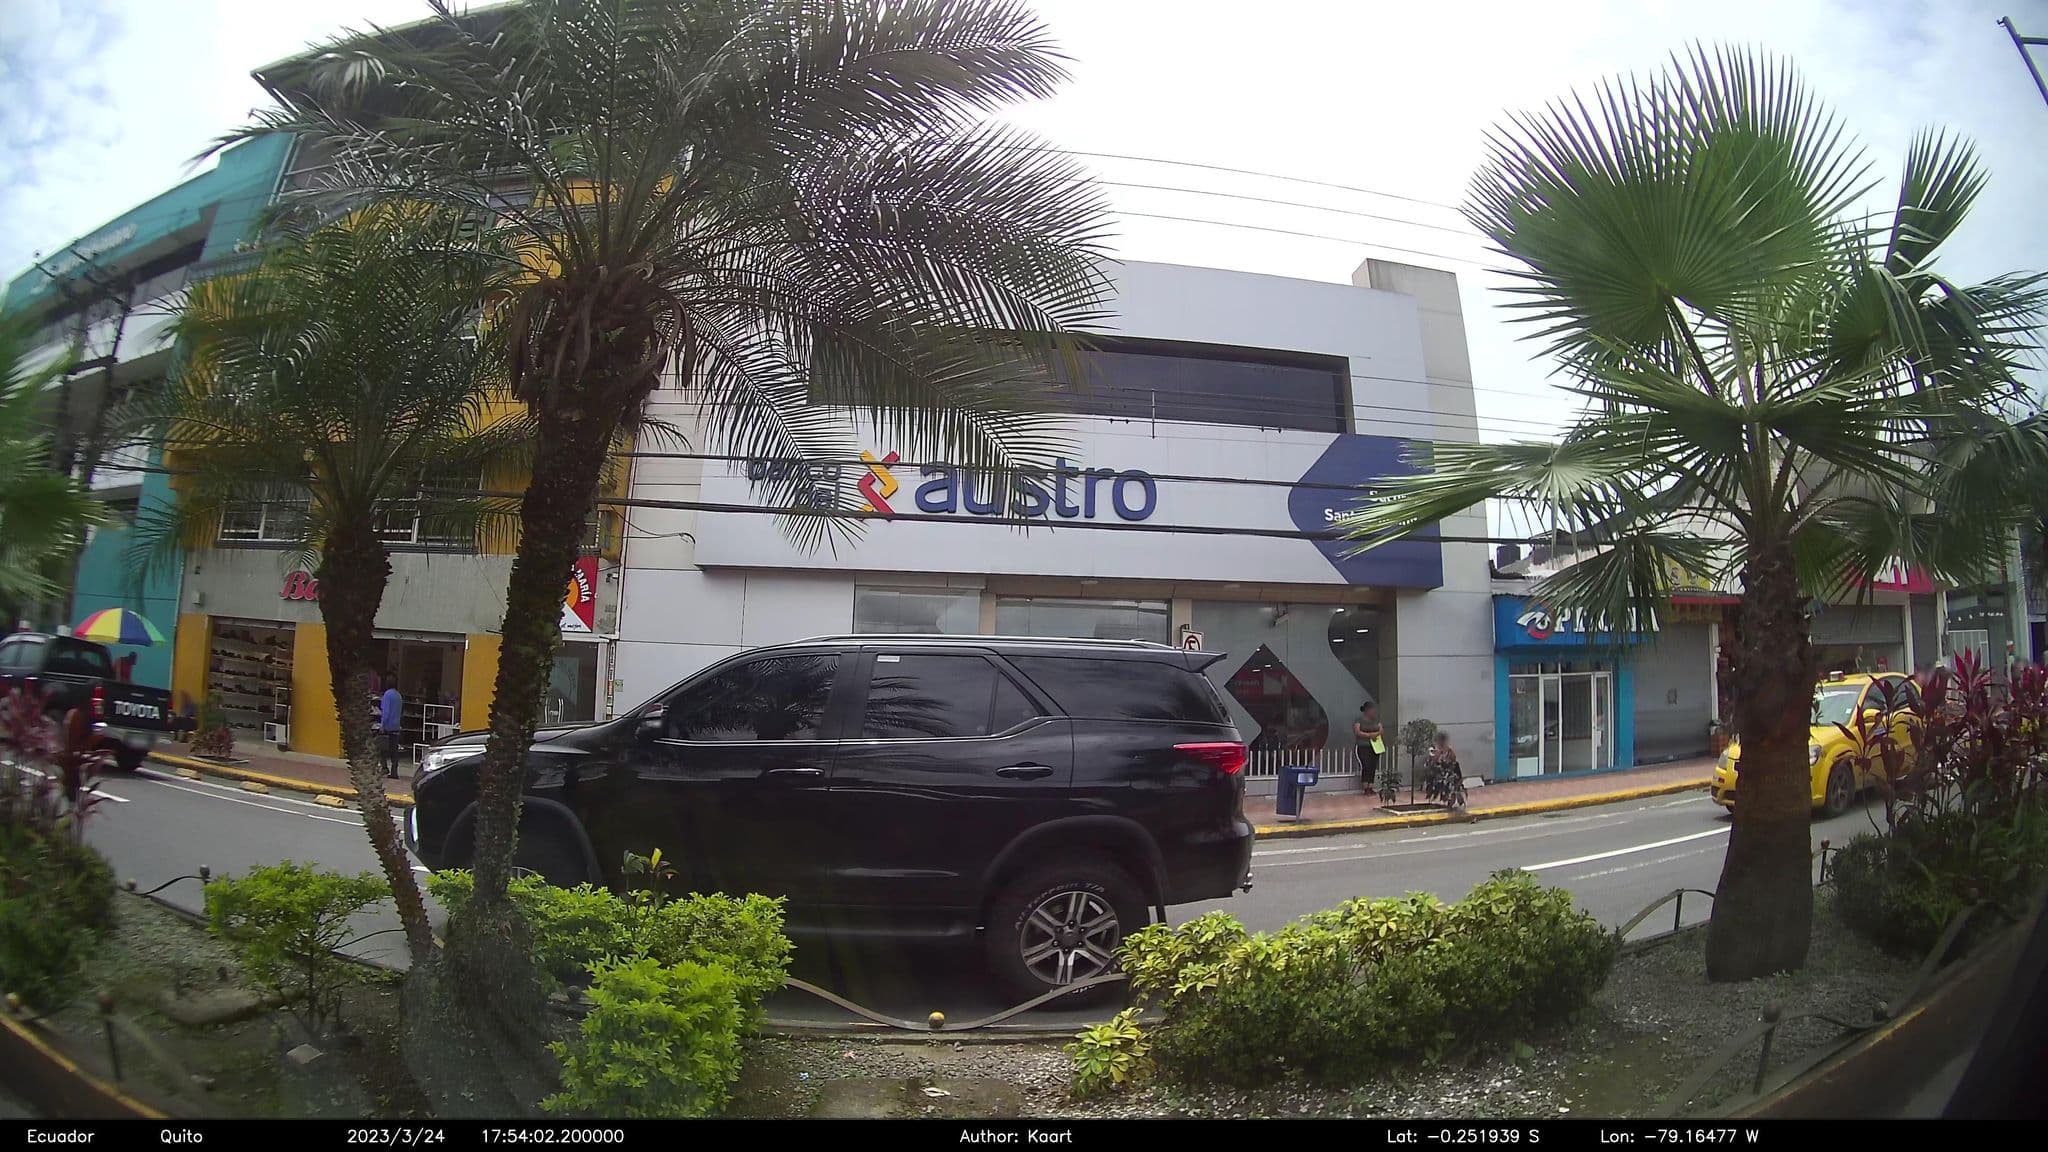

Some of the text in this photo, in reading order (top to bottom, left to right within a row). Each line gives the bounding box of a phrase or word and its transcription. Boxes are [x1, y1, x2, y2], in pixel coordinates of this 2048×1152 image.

[748, 453, 841, 481] baco
[915, 457, 1157, 521] austro
[114, 701, 160, 719] TOYOTA
